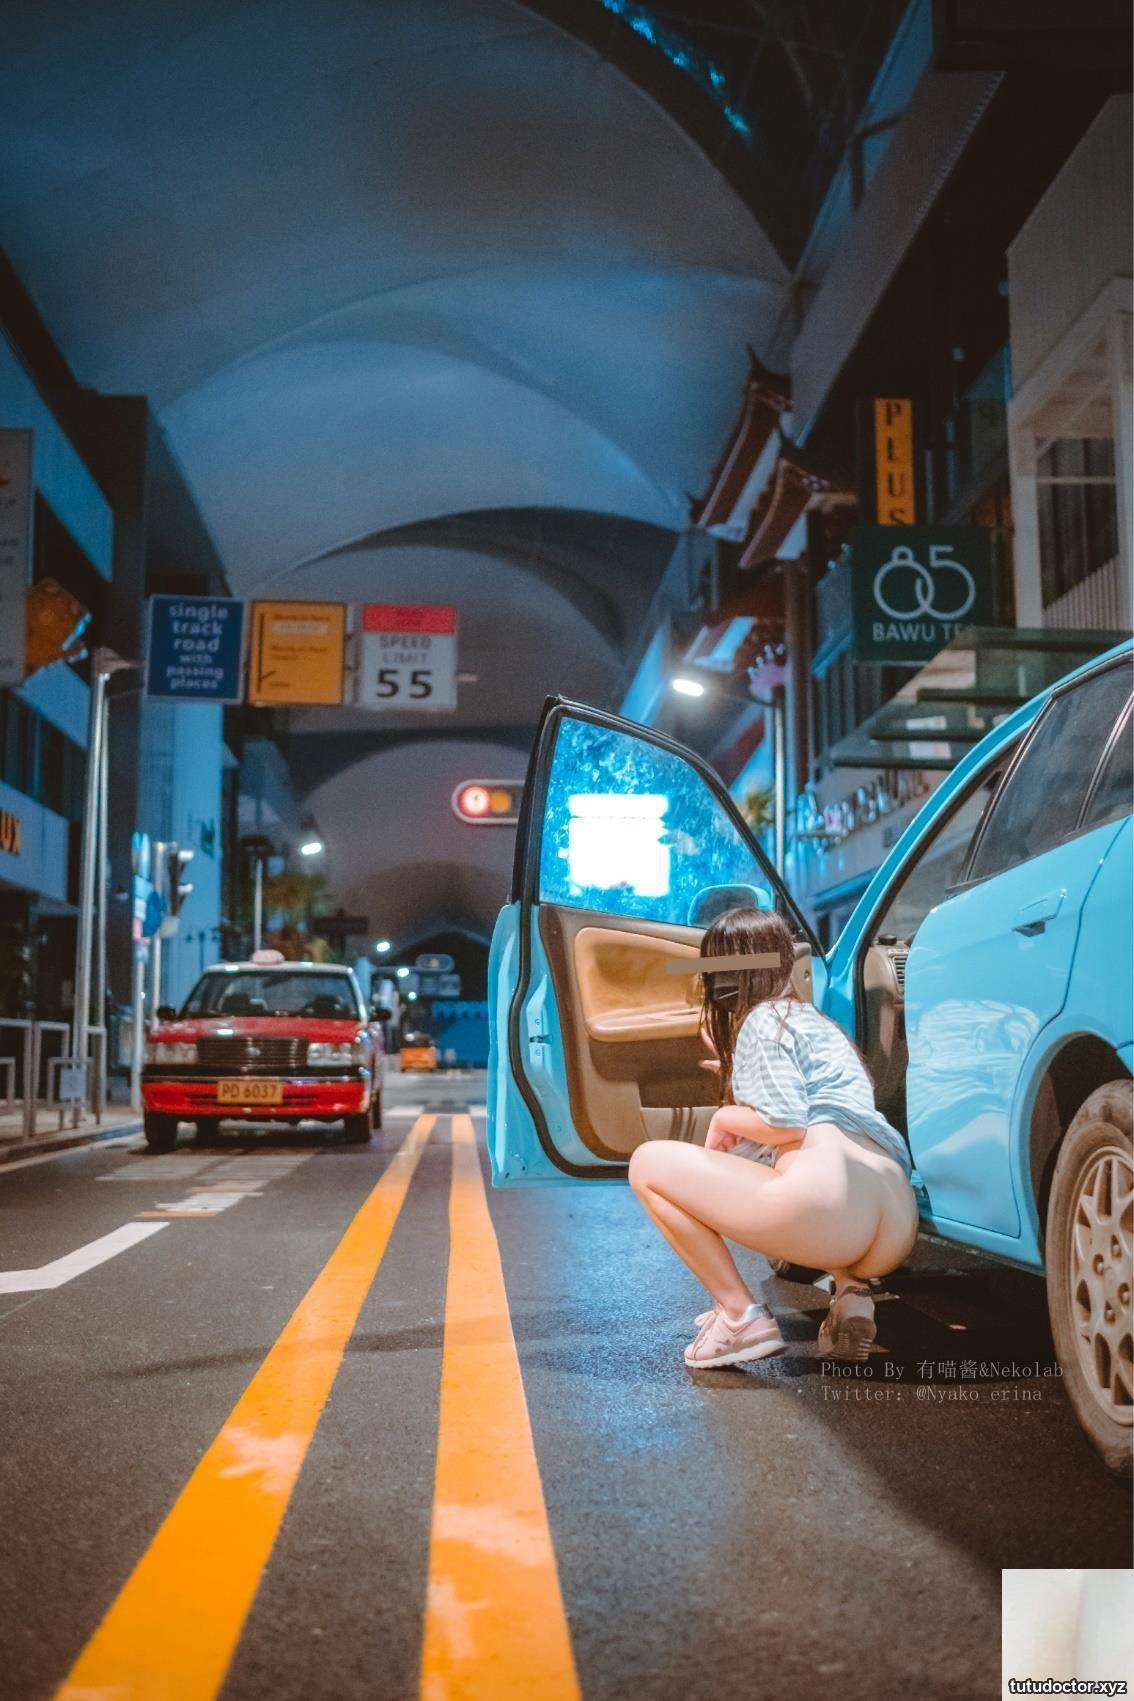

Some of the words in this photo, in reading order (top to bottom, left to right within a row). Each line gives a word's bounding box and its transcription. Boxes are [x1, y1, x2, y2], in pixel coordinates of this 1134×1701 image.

[169, 603, 228, 622] single
[173, 621, 222, 635] track
[872, 623, 936, 642] BAWU
[174, 637, 220, 652] road
[380, 635, 432, 650] SPEED
[179, 654, 213, 664] with
[383, 653, 429, 664] LIMIT
[166, 666, 224, 679] passing
[170, 677, 218, 689] places
[376, 669, 433, 699] 55
[222, 1084, 240, 1099] PD
[244, 1084, 277, 1099] 6037
